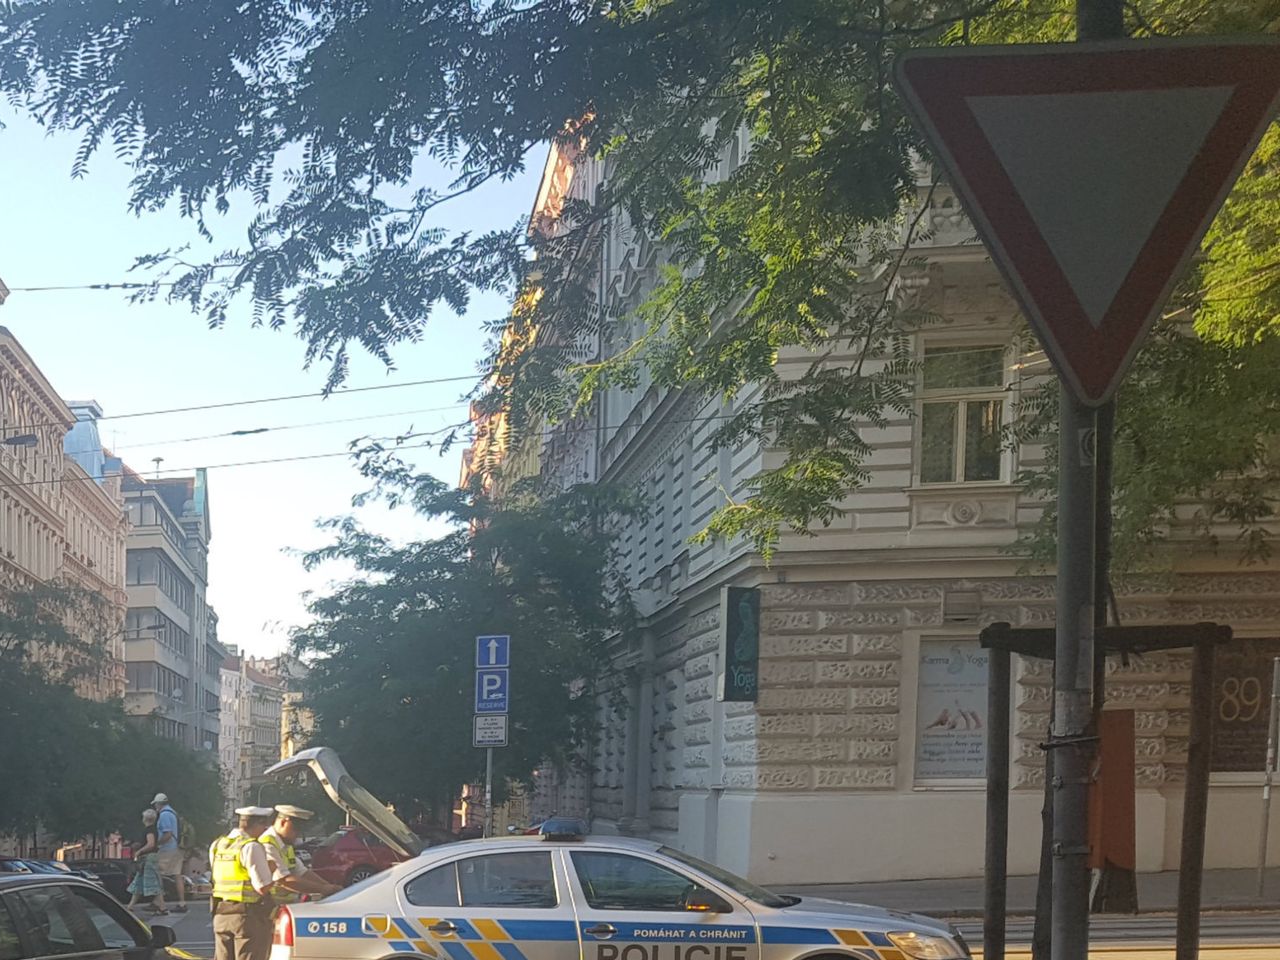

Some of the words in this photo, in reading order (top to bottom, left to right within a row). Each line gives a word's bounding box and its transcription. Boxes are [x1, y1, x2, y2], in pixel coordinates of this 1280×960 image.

[483, 674, 502, 700] P
[1220, 676, 1261, 721] 89
[322, 922, 347, 933] 158
[633, 928, 684, 938] POMÁHAT
[689, 930, 696, 938] A
[699, 928, 747, 939] CHRÁNIT
